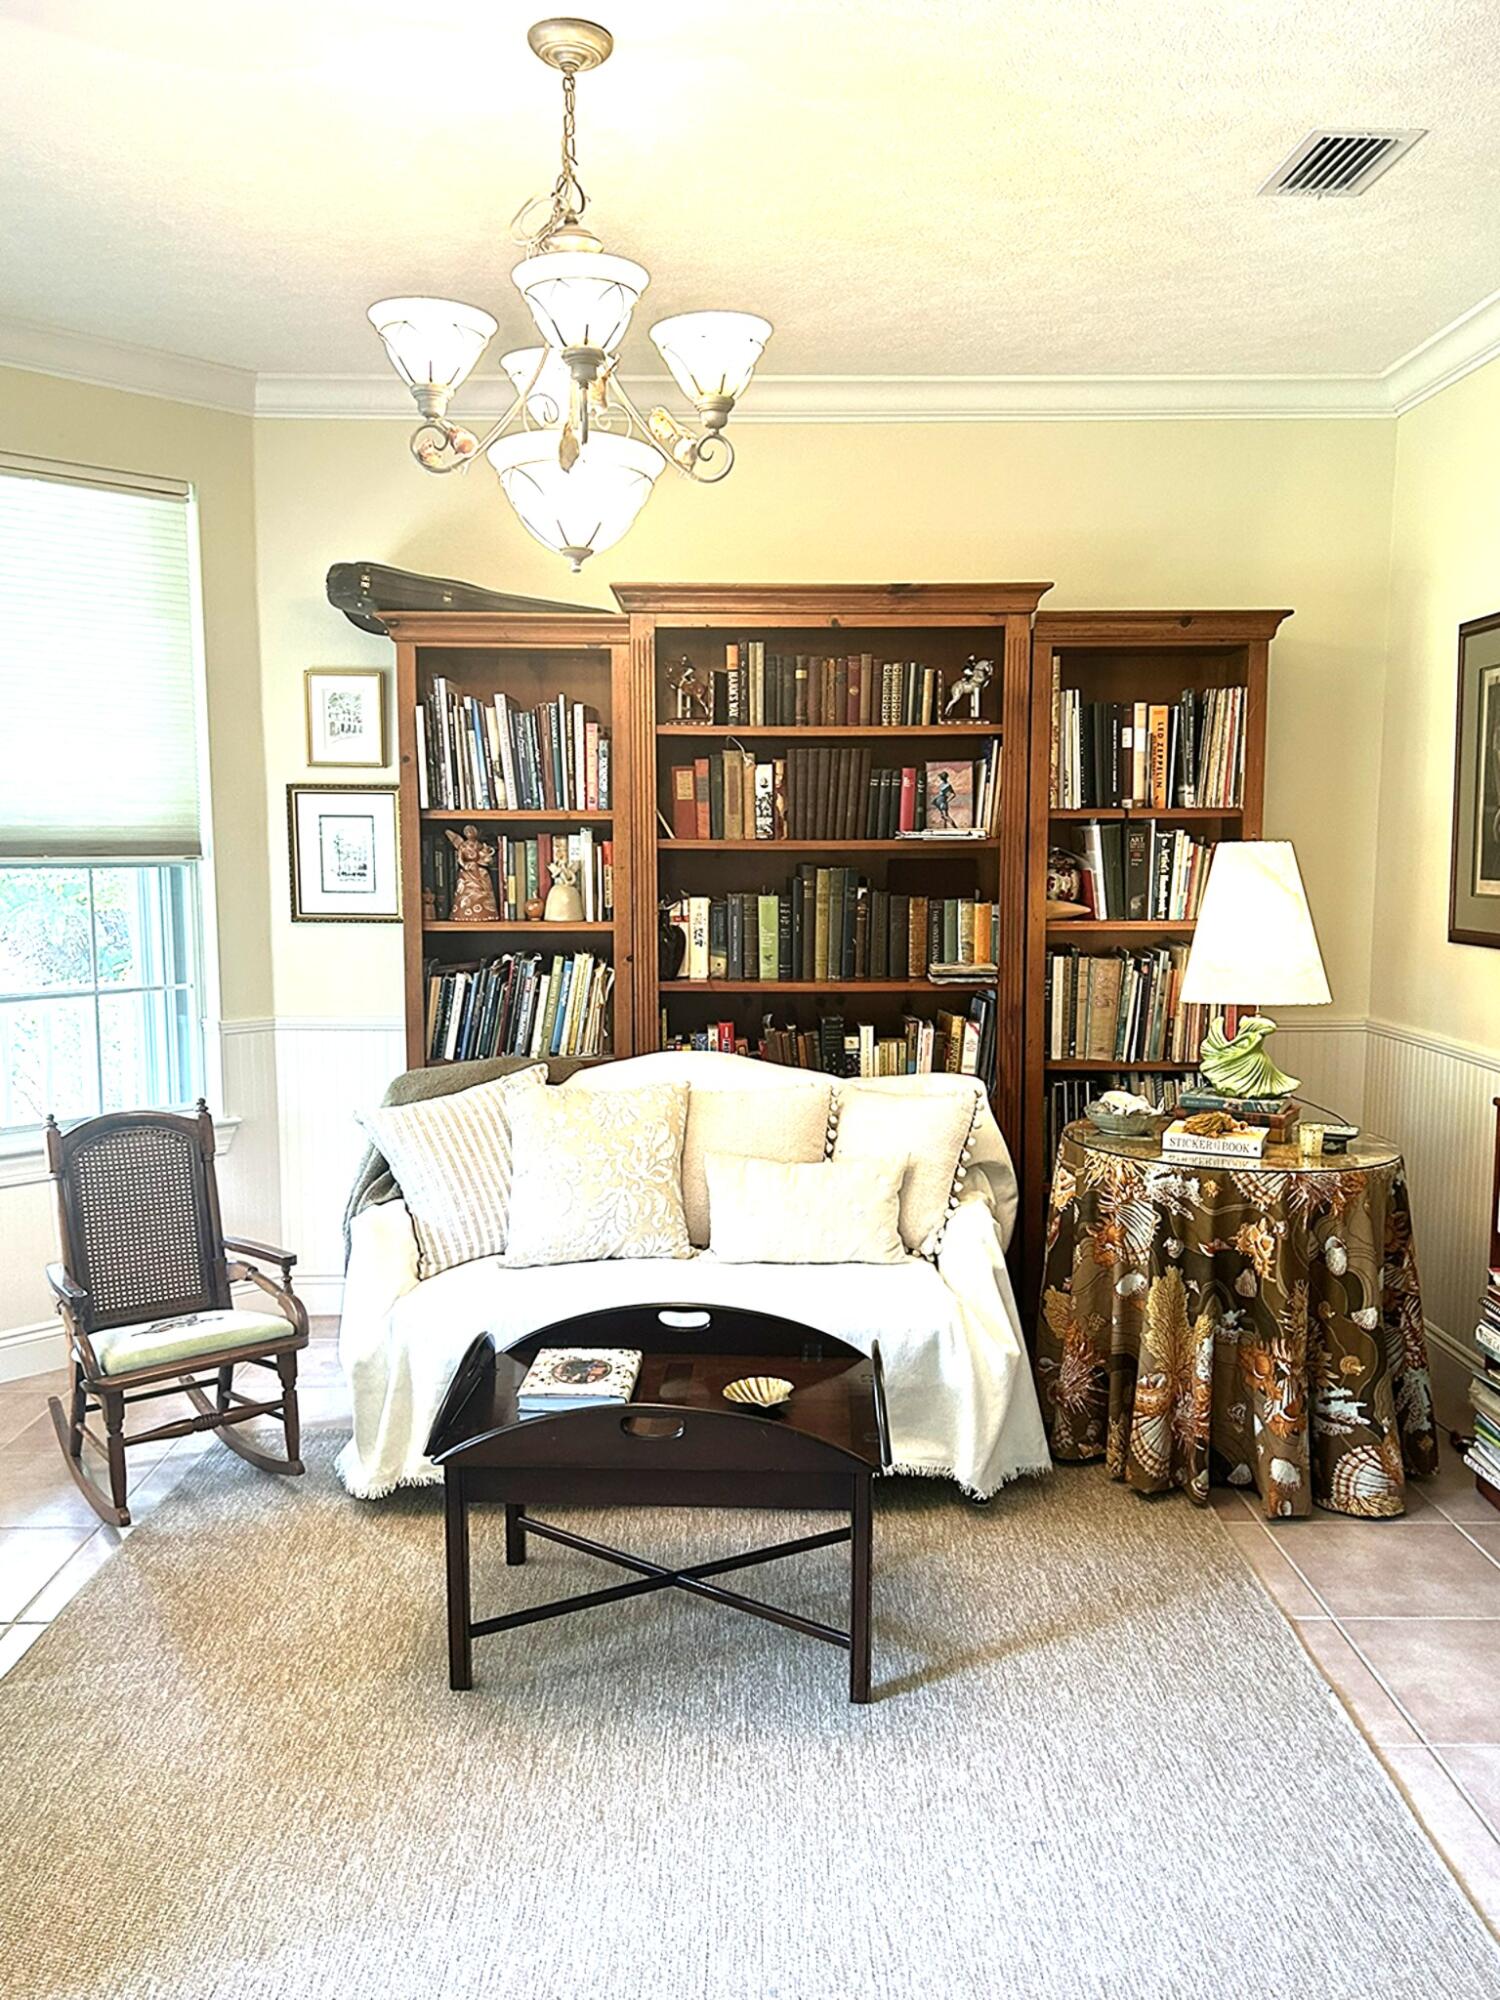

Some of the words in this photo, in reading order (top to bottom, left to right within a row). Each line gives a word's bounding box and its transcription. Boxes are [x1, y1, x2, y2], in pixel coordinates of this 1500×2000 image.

[1157, 721, 1165, 739] LED
[1156, 741, 1164, 789] ZEPPELIN
[1169, 1138, 1213, 1150] STICKER
[1222, 1141, 1250, 1154] BOOK
